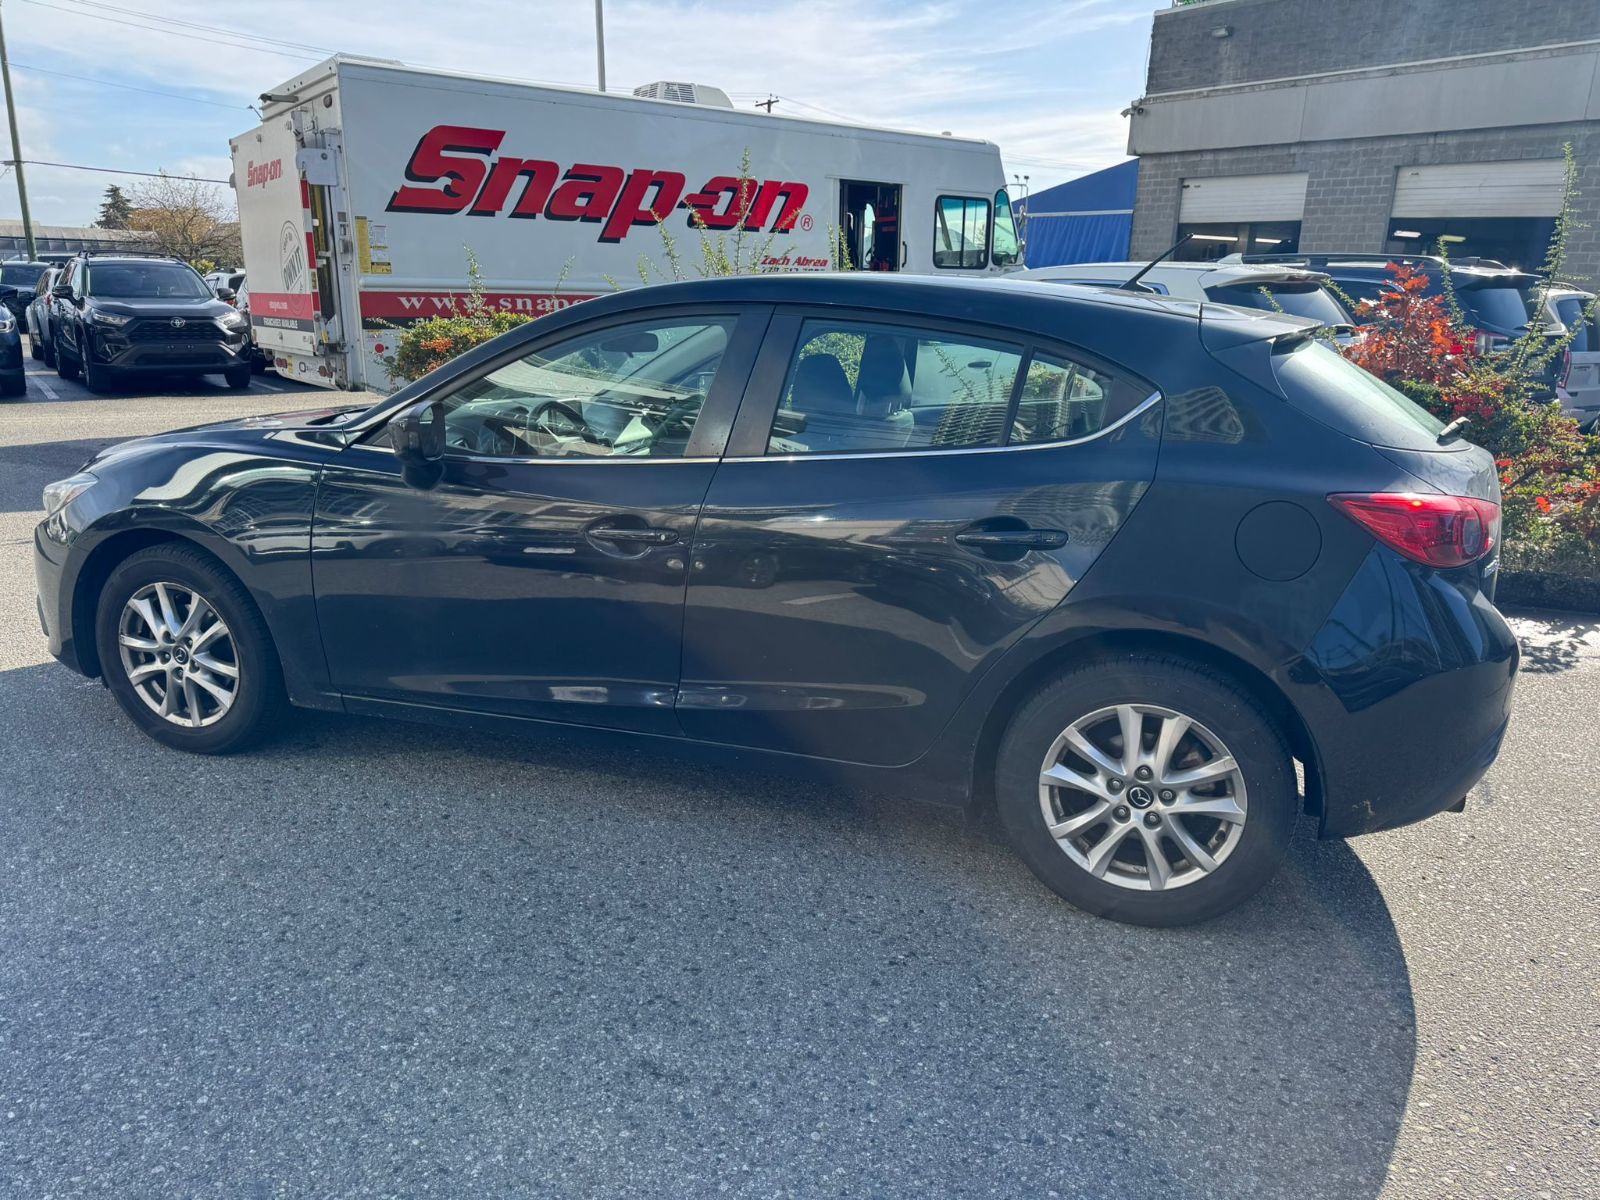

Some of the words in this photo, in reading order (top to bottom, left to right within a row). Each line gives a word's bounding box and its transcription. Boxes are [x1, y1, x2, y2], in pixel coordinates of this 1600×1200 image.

[247, 159, 282, 189] Snap-on
[385, 125, 809, 243] Snap-on
[761, 255, 790, 266] Zach
[397, 296, 588, 311] www.snap
